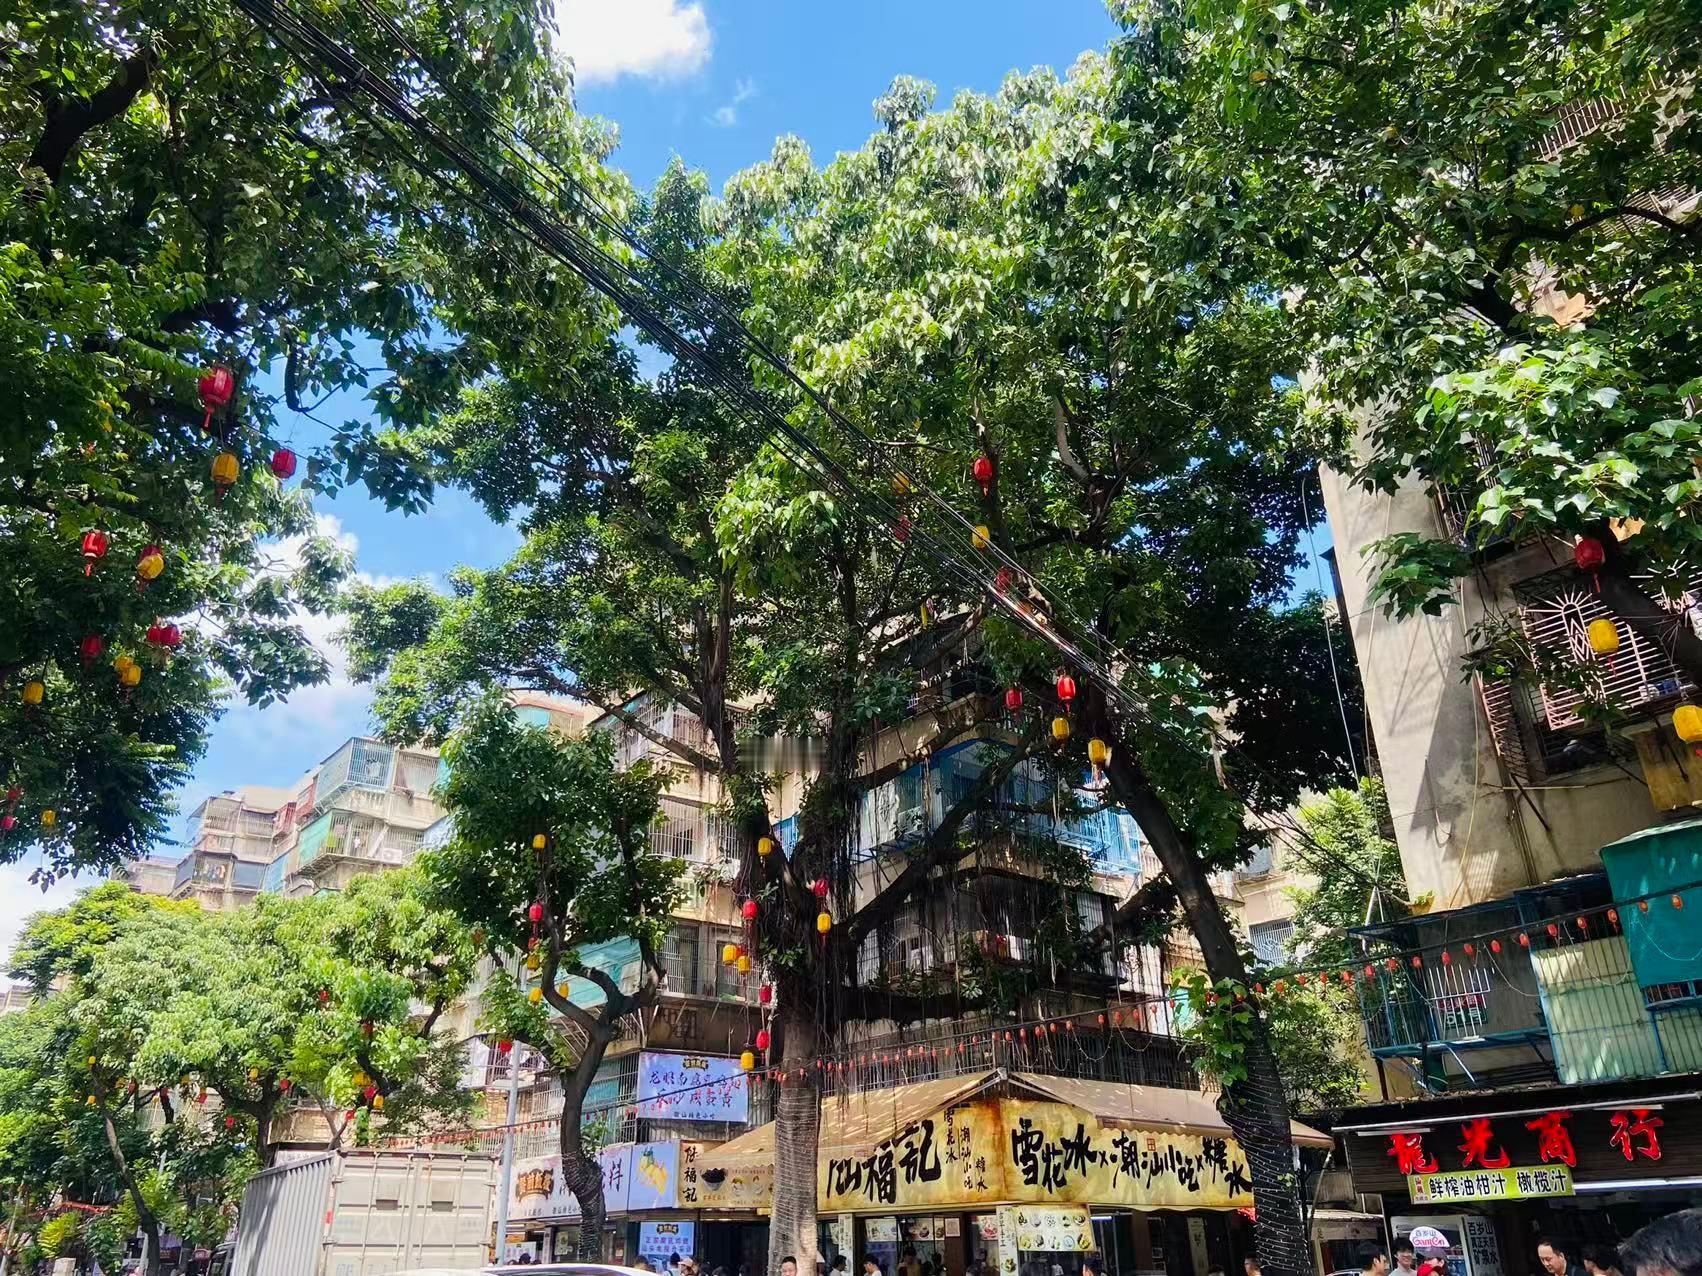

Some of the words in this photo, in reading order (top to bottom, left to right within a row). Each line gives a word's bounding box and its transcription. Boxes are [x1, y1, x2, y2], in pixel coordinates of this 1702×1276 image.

[1429, 1174, 1506, 1199] 鲜榨油柑汁
[1517, 1169, 1567, 1193] 橄榄汁
[1467, 1221, 1495, 1236] 百岁山
